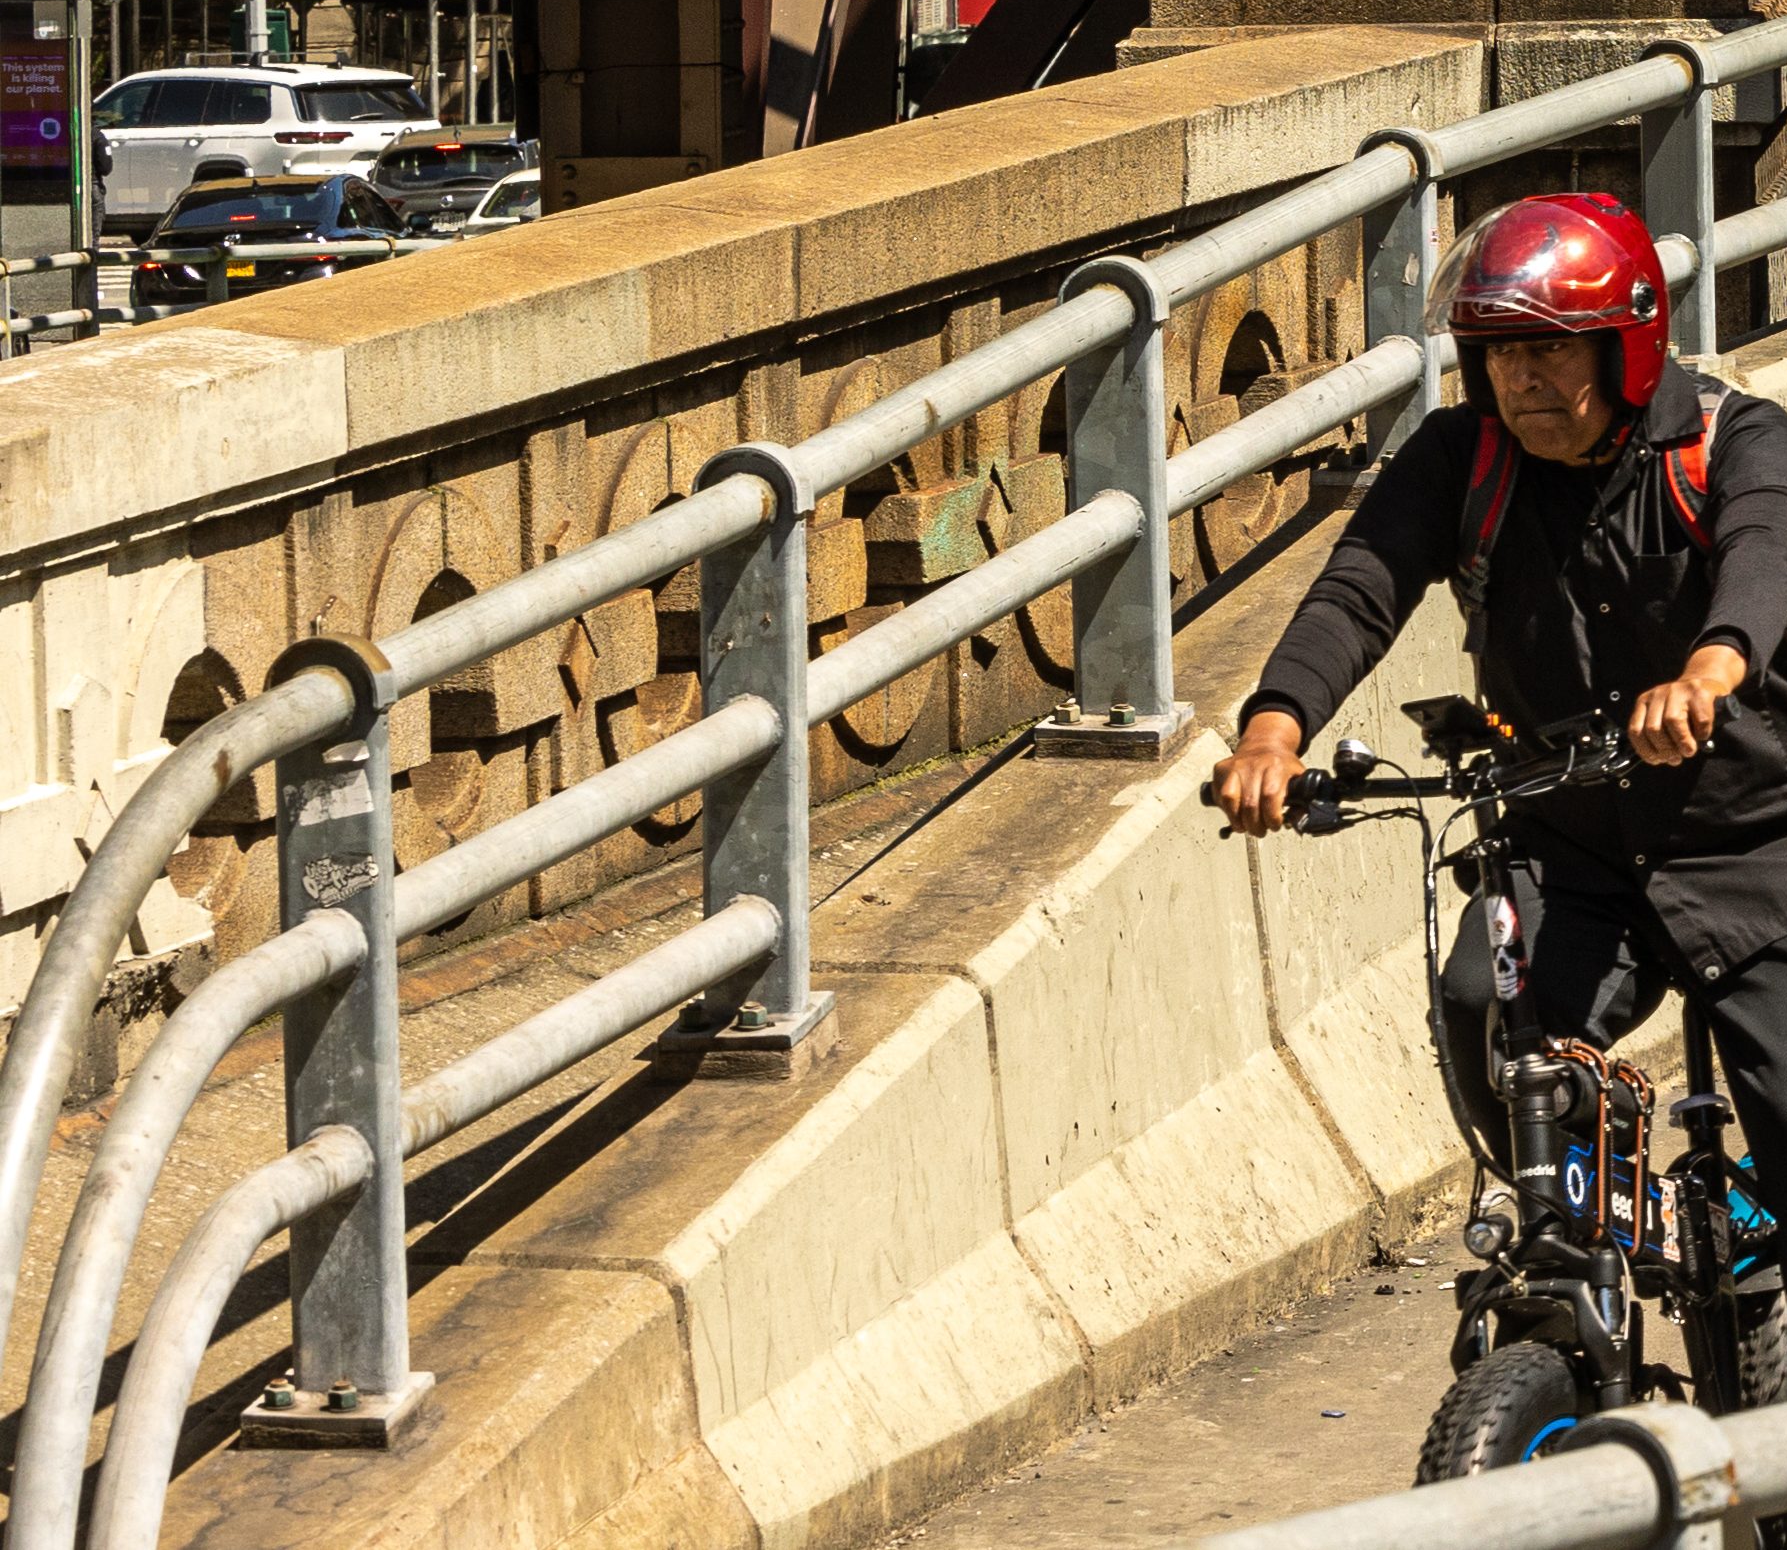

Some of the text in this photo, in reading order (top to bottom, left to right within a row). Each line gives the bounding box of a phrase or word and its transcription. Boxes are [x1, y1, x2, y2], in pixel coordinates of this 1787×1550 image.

[3, 63, 65, 74] This system
[11, 73, 55, 85] is killing
[6, 85, 23, 93] our
